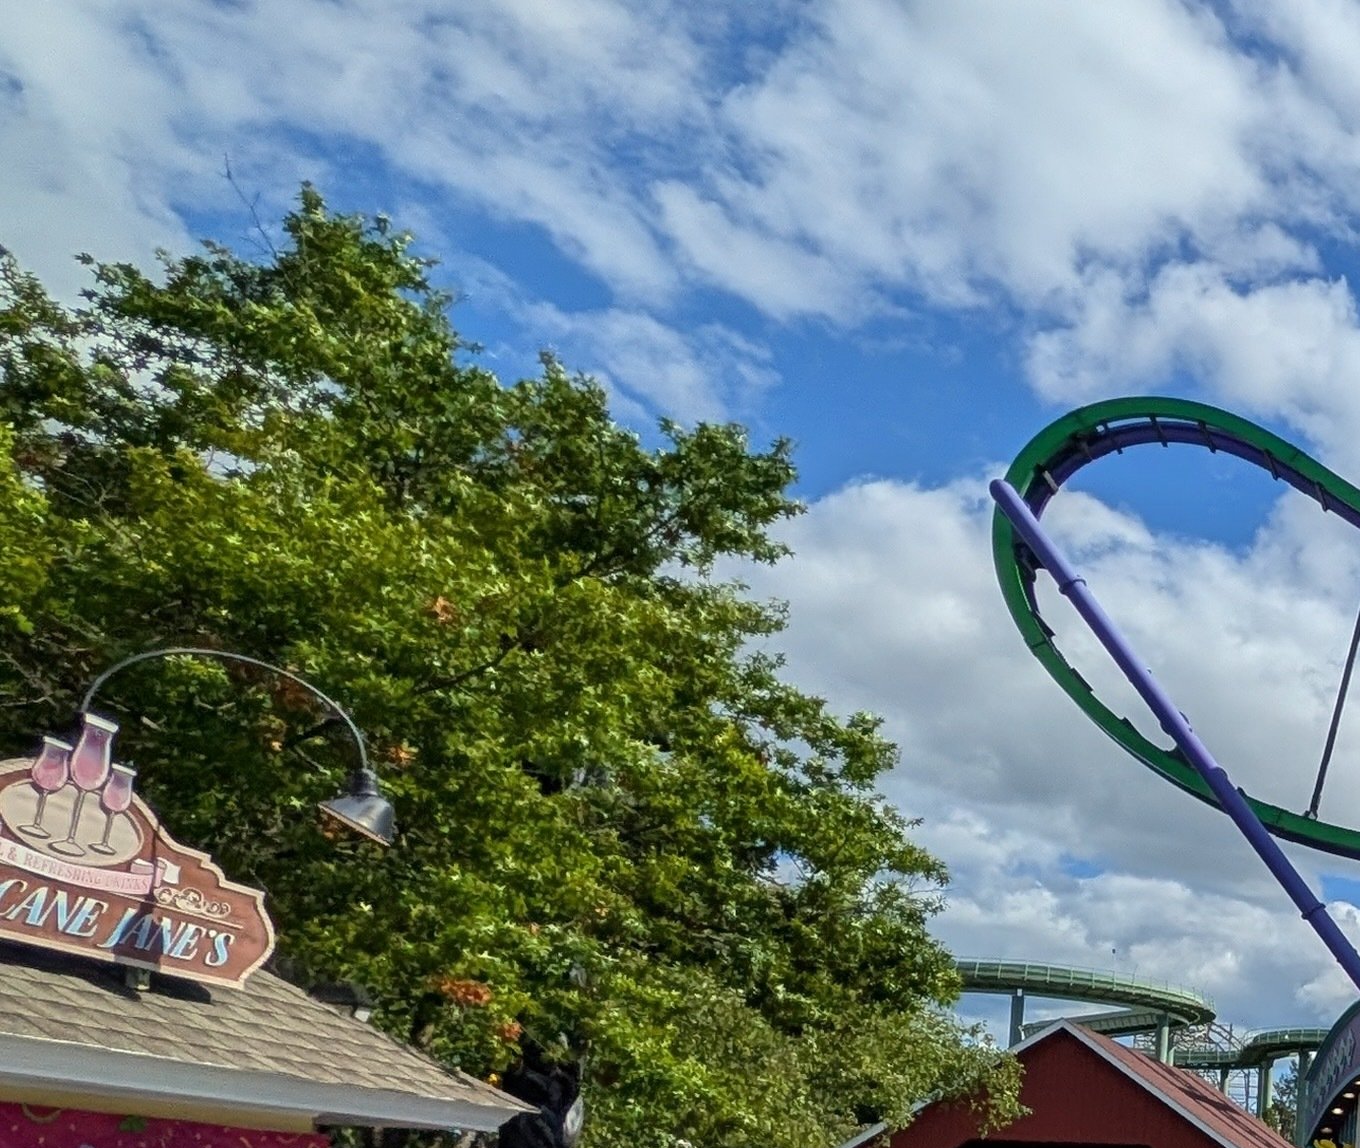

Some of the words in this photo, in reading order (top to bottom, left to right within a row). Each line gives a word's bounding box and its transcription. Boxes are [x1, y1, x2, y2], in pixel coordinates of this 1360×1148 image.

[7, 847, 17, 862] &
[24, 853, 101, 885] REFRESHING
[105, 875, 149, 891] DRINKS
[96, 906, 236, 967] JANE'S
